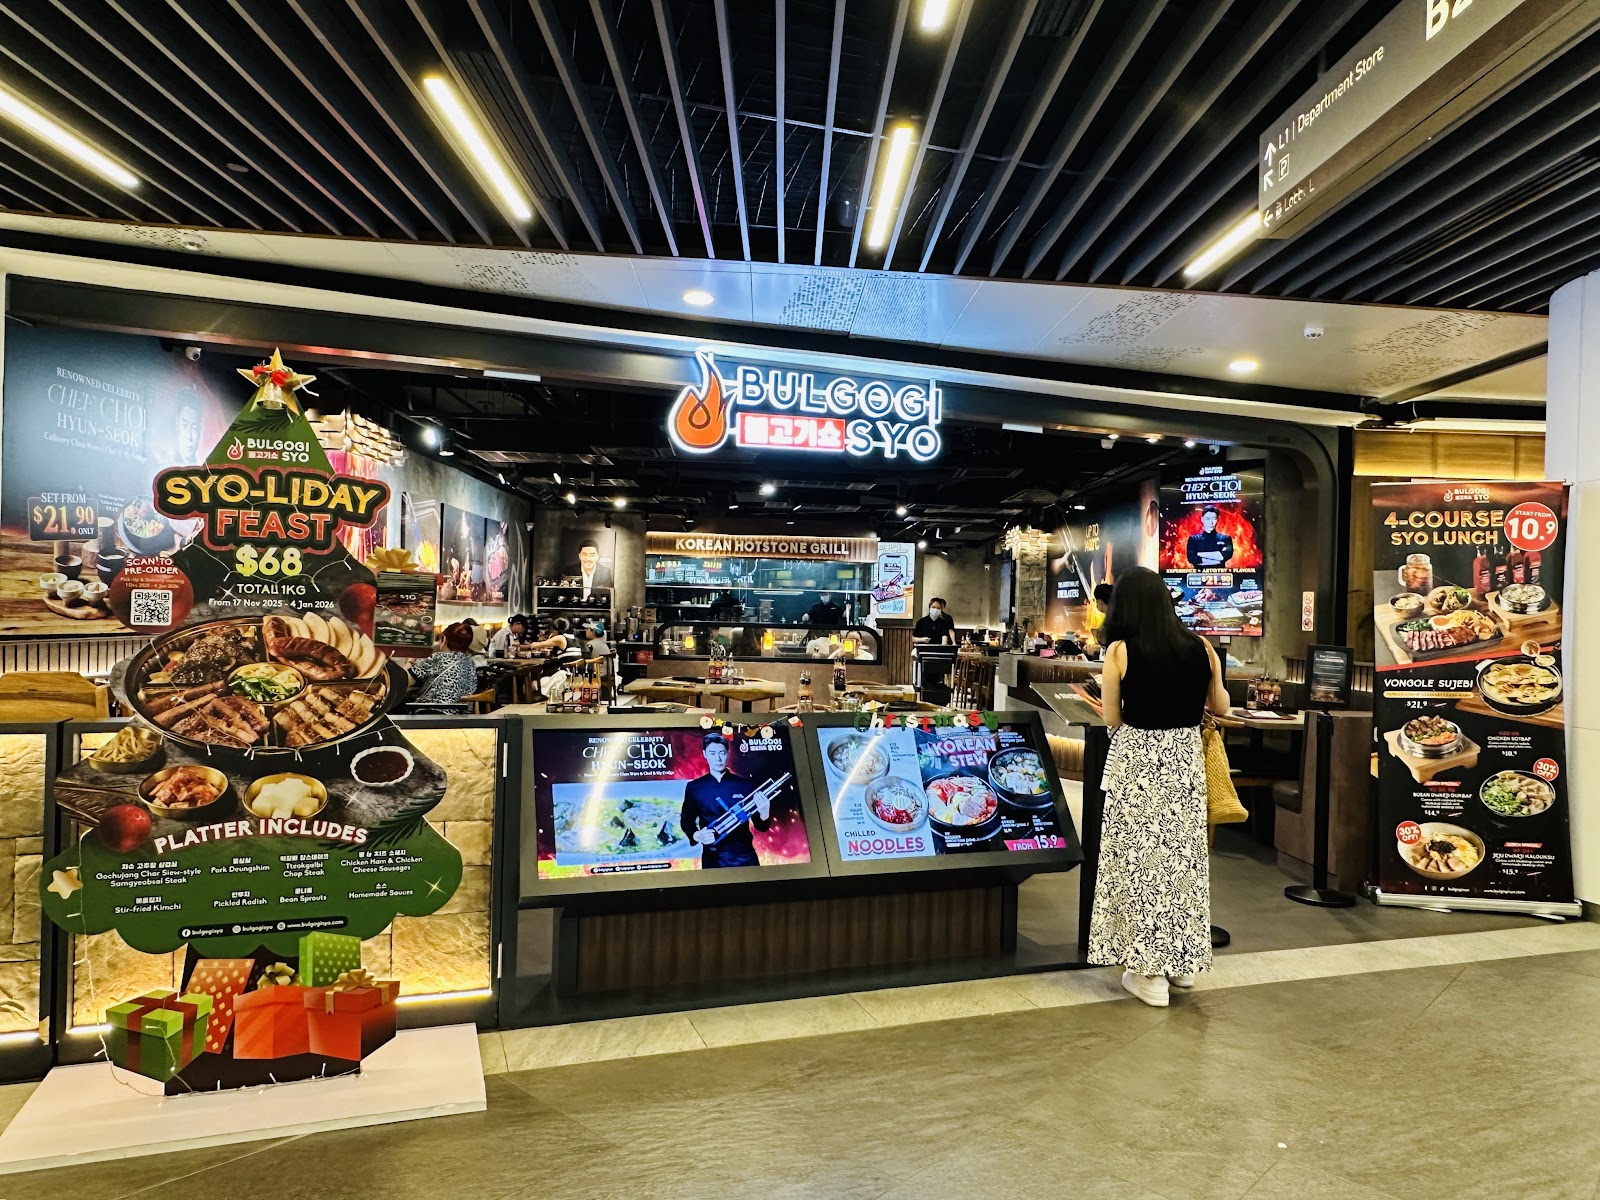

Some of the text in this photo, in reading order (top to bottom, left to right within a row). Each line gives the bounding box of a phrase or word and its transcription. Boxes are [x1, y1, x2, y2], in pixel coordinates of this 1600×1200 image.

[1278, 46, 1384, 149] L1 Department Store
[1284, 179, 1315, 211] Lobb L
[57, 367, 140, 402] RENOWNED CELEBRITY
[737, 366, 942, 424] BULGOGI
[48, 383, 147, 431] CHEF CHOI
[57, 412, 138, 448] HYUN-SEOK
[247, 438, 310, 452] BULGOGI
[846, 419, 941, 461] SYO
[281, 451, 310, 463] SYO
[1180, 480, 1242, 492] CHEF CHOI
[41, 492, 59, 503] SET
[60, 493, 86, 504] FROM
[165, 474, 379, 514] SYO-LIDAY
[1186, 491, 1236, 500] HYUN-SEOK
[216, 508, 331, 540] FEAST
[1384, 510, 1504, 529] 4-COURSE
[78, 527, 94, 535] ONLY
[1508, 517, 1556, 540] 10.9
[1390, 530, 1498, 546] SYO LUNCH
[676, 538, 849, 555] KOREAN HOTSTONE GRILL
[126, 557, 173, 566] SCAN TO
[235, 544, 303, 576] $68
[124, 566, 179, 575] PRE-ORDER
[237, 584, 306, 595] TOTAL 1KG
[208, 598, 231, 607] From
[233, 598, 242, 607] 17
[244, 599, 260, 607] Nov
[262, 599, 283, 607] 2025
[297, 600, 313, 609] Jan
[1384, 679, 1473, 690] VONGOLE SUJEBI
[1406, 700, 1428, 708] $21.9
[854, 709, 982, 733] Christmas
[627, 744, 673, 758] CHOI
[930, 738, 997, 757] KOREAN
[949, 751, 988, 767] STEW
[1536, 761, 1557, 773] 30%
[154, 818, 369, 854] PLATTER INCLUDES
[845, 830, 876, 838] CHILLED
[1399, 826, 1420, 835] 30%
[848, 837, 925, 856] NOODLES
[1034, 835, 1058, 849] 15.9
[96, 872, 139, 880] Gochujang
[161, 868, 201, 876] Siew-style
[229, 865, 270, 873] Deungshim
[283, 870, 302, 878] Chop
[110, 878, 163, 888] Samgyeobsal
[299, 894, 327, 903] Sprouts
[349, 891, 387, 899] Homemade
[114, 903, 181, 914] Stir-fried Kimchi
[213, 899, 240, 907] Pickled
